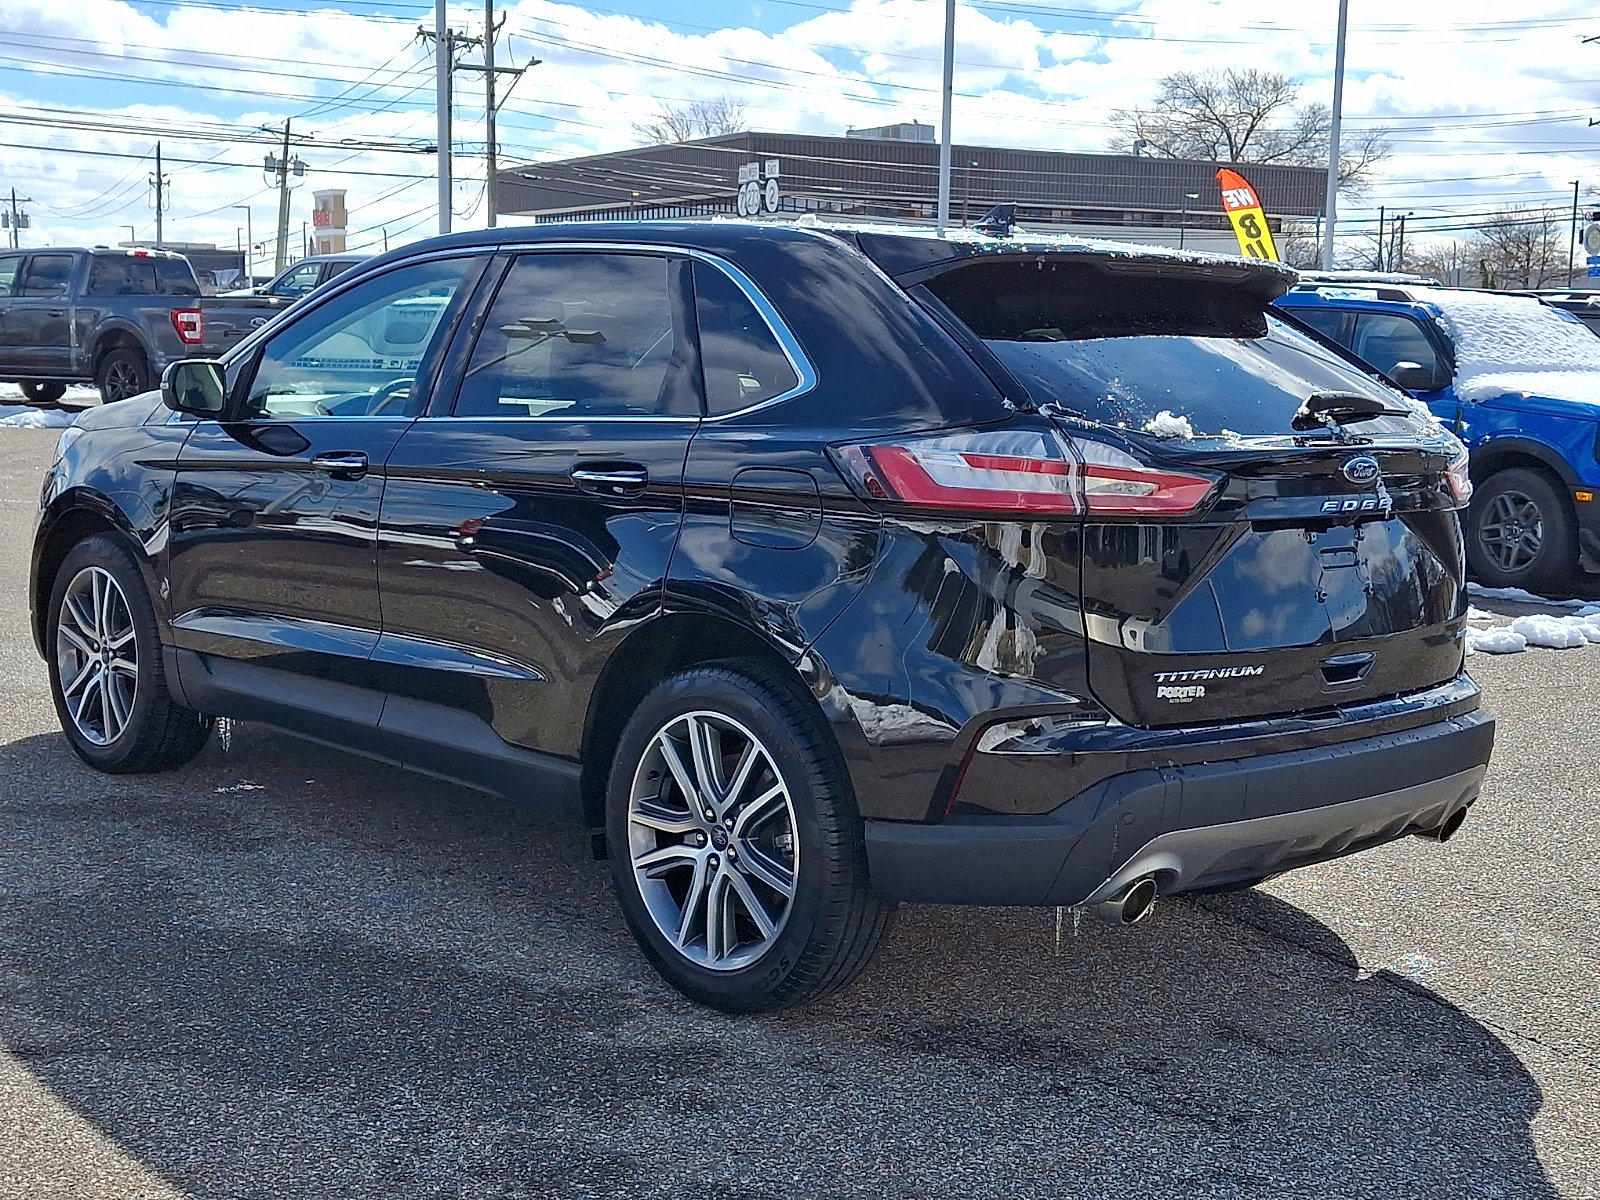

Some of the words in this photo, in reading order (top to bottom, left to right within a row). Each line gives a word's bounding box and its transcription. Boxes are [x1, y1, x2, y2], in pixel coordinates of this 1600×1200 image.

[769, 186, 776, 205] 2
[1321, 498, 1391, 513] EDGE
[1153, 664, 1266, 683] TITANIUM
[1156, 685, 1206, 699] PORTER
